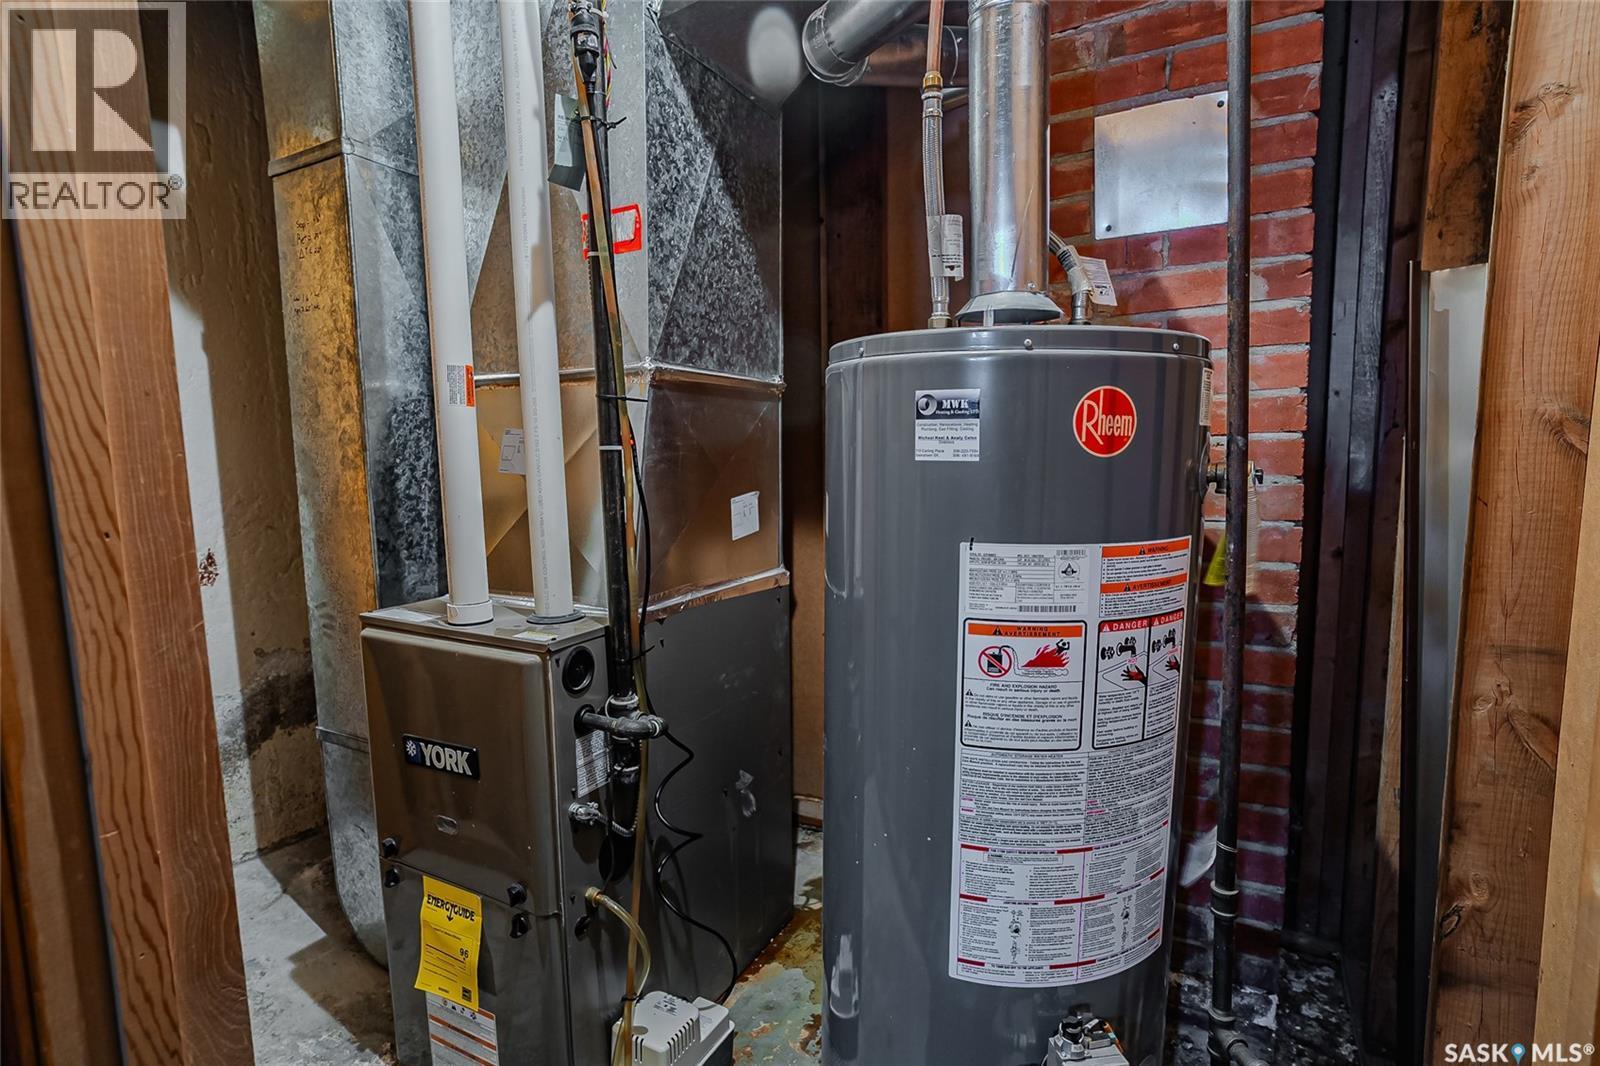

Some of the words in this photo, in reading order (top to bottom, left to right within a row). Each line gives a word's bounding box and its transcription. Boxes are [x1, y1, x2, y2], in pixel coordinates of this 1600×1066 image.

[942, 400, 969, 408] MWK
[1082, 389, 1132, 445] Rheem
[1161, 611, 1183, 624] DANGER
[1113, 620, 1148, 630] DANGER
[420, 742, 472, 776] YORK
[460, 948, 469, 959] 96
